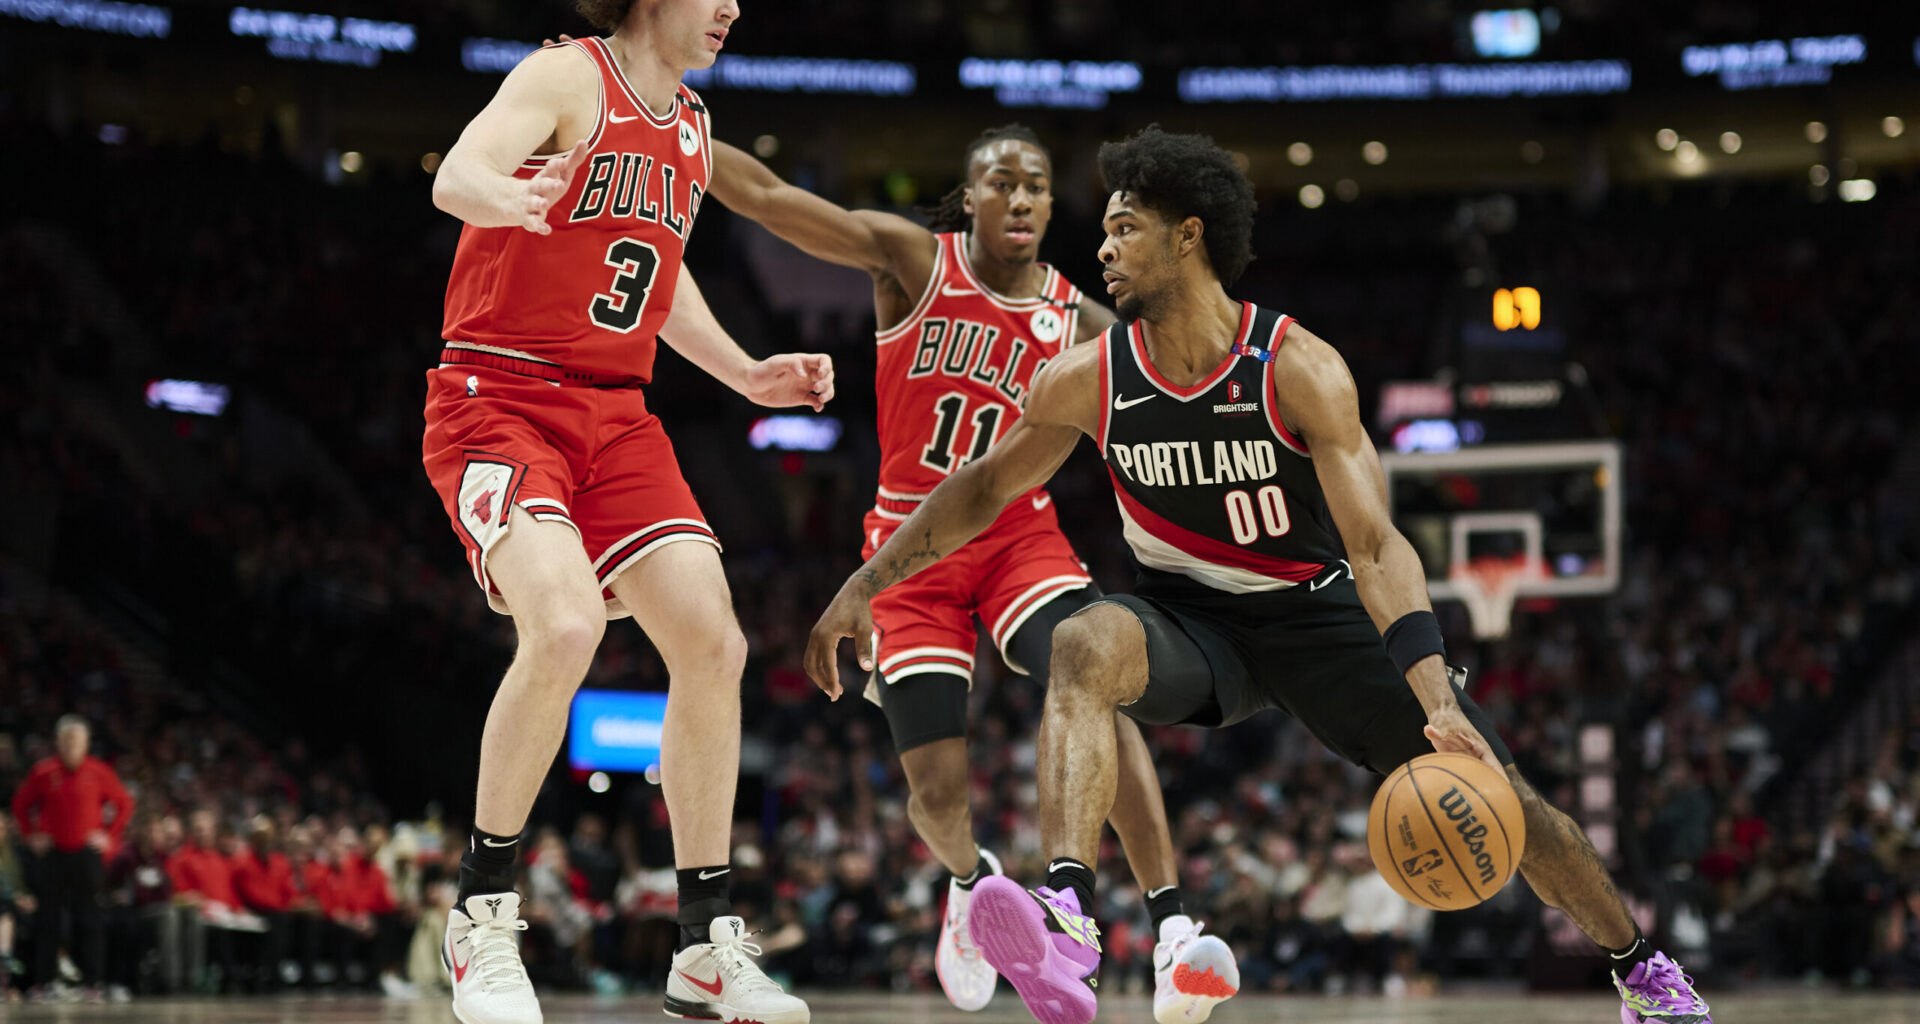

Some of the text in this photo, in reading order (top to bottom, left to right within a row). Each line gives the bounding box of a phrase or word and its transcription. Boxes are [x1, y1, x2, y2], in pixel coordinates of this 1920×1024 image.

[588, 236, 661, 334] 3
[907, 317, 1048, 415] BULL
[1248, 346, 1261, 358] 32
[920, 391, 1005, 475] 11
[1213, 402, 1259, 414] BRIGHTSIDE
[1110, 440, 1278, 487] PORTLAND
[1224, 485, 1291, 546] 00
[1438, 785, 1497, 886] Wilson
